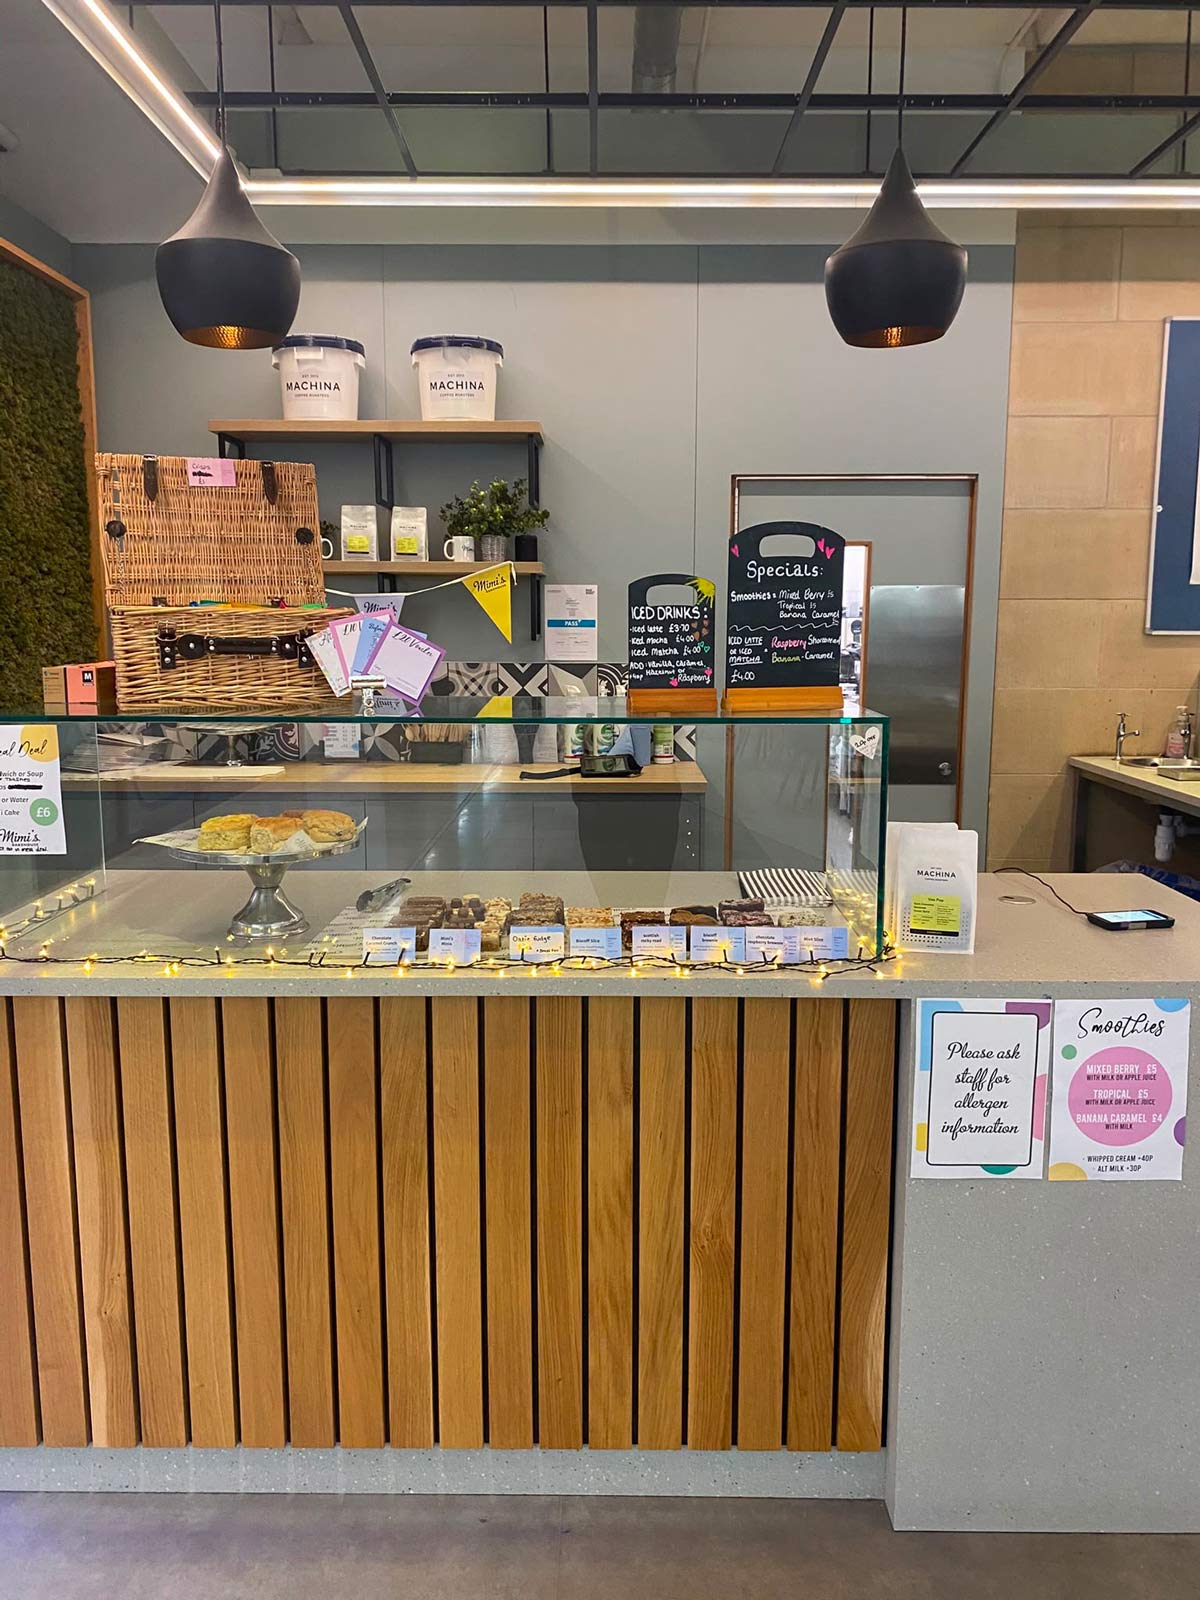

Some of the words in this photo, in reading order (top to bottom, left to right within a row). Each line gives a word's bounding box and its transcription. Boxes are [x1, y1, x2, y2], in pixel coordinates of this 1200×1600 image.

[286, 381, 341, 391] MACHINA
[430, 380, 484, 390] MACHINA
[746, 560, 824, 582] Specials:
[473, 574, 506, 592] Mimi's
[804, 588, 825, 600] Berry
[777, 600, 806, 611] Tropical
[631, 606, 655, 620] ICED
[812, 610, 840, 619] Caramel
[745, 636, 763, 646] LATTE
[772, 636, 806, 650] Raspberry
[729, 656, 760, 664] MATCHA
[772, 652, 800, 663] Banana
[678, 673, 710, 684] Raspberry
[18, 740, 48, 758] Deal
[36, 807, 50, 818] £6
[0, 828, 40, 843] Mimi's
[917, 870, 956, 878] MACHINA
[1078, 1007, 1166, 1039] Smoothies
[946, 1041, 994, 1060] Please
[996, 1043, 1021, 1060] ask
[1086, 1064, 1112, 1074] MIXED
[1114, 1064, 1139, 1074] BERRY
[1146, 1064, 1157, 1074] £5
[955, 1068, 987, 1091] staff
[987, 1068, 1011, 1091] for
[1094, 1090, 1131, 1099] TROPICAL
[1137, 1089, 1148, 1098] £5
[954, 1093, 1008, 1118] allergen
[1076, 1114, 1108, 1123] BANANA
[1111, 1114, 1147, 1123] CARAMEL
[1152, 1114, 1162, 1123] £4
[941, 1117, 1019, 1140] information
